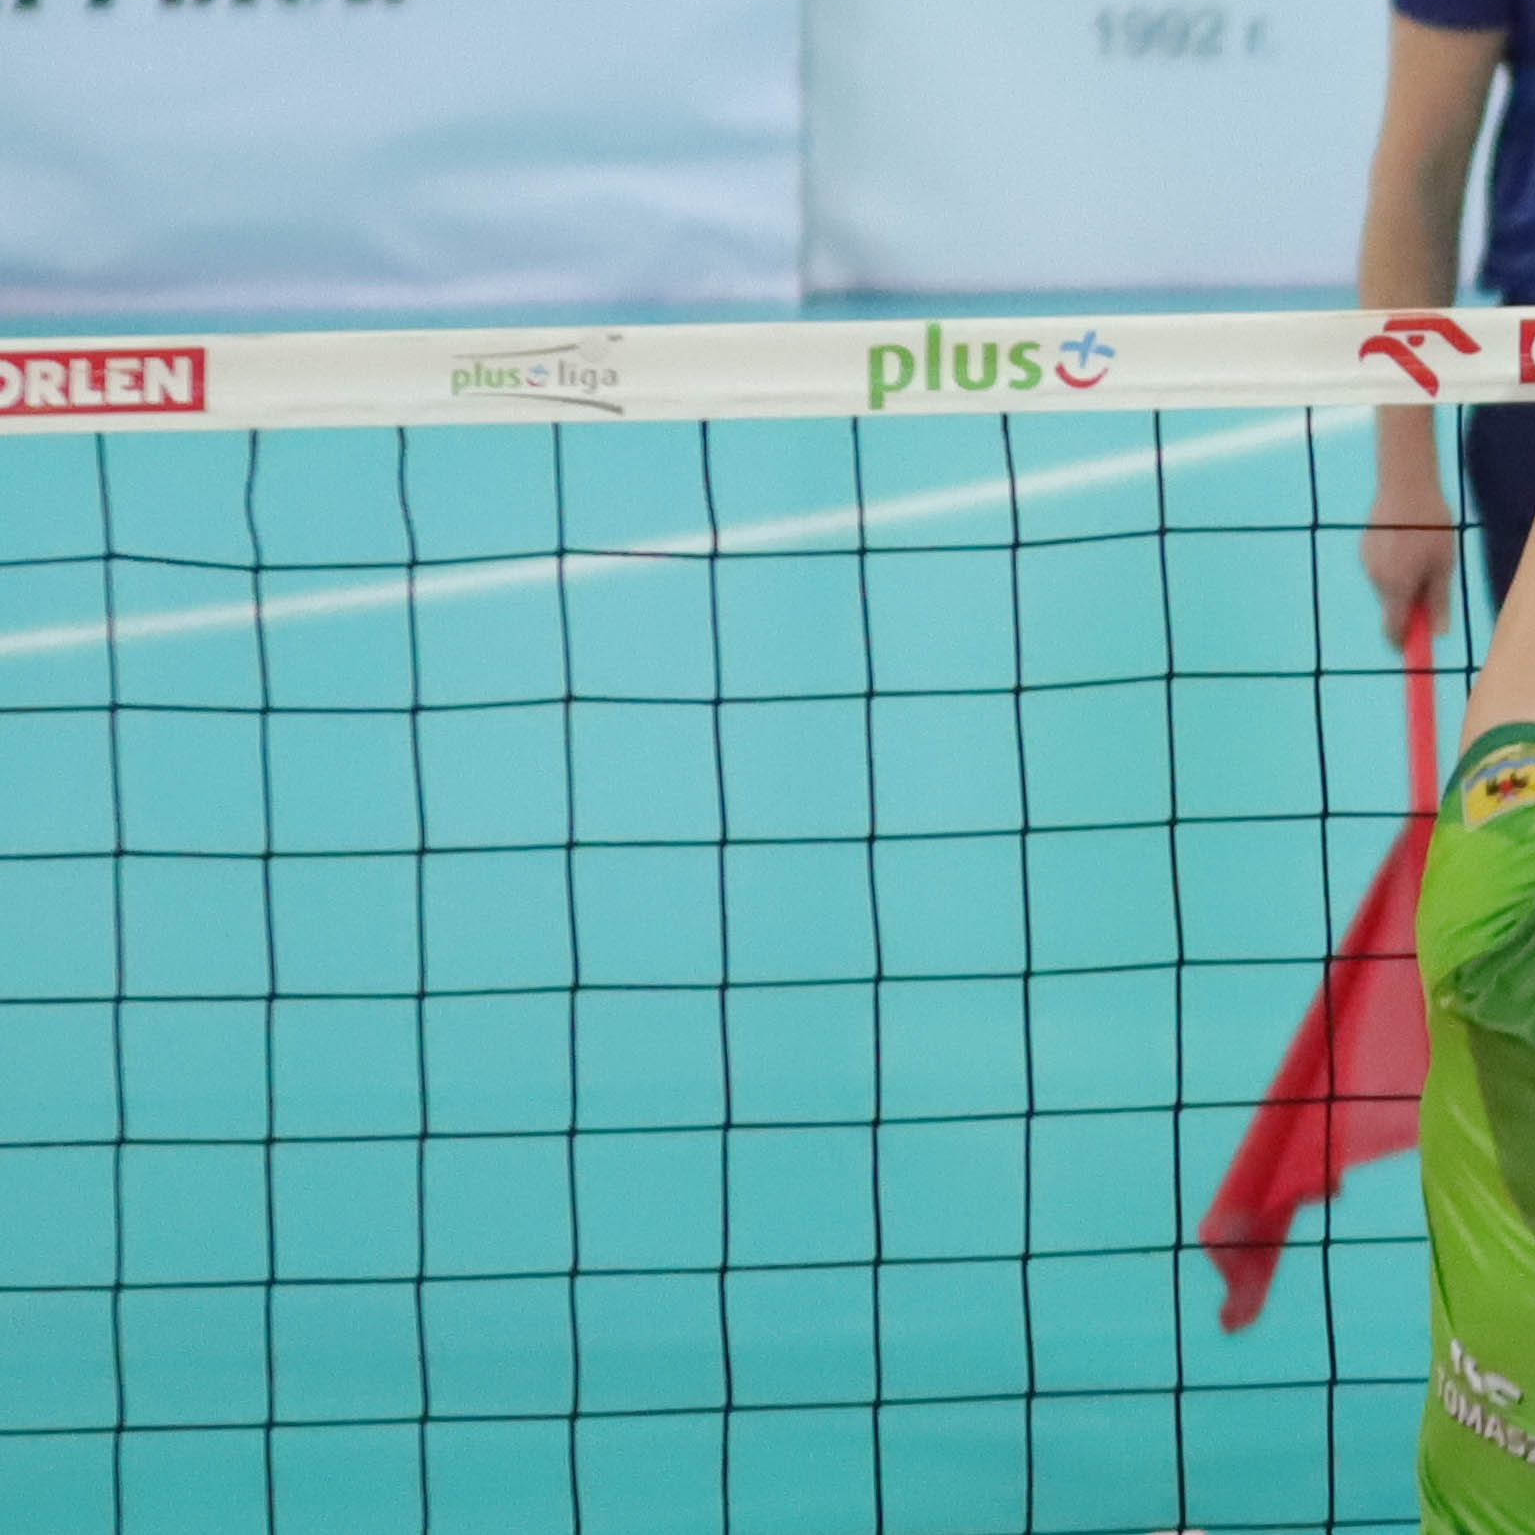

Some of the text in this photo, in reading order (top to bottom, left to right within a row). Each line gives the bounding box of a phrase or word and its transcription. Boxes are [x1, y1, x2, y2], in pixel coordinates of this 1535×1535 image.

[1096, 8, 1227, 59] 1992
[452, 359, 619, 396] plus liga
[868, 321, 1043, 411] plus
